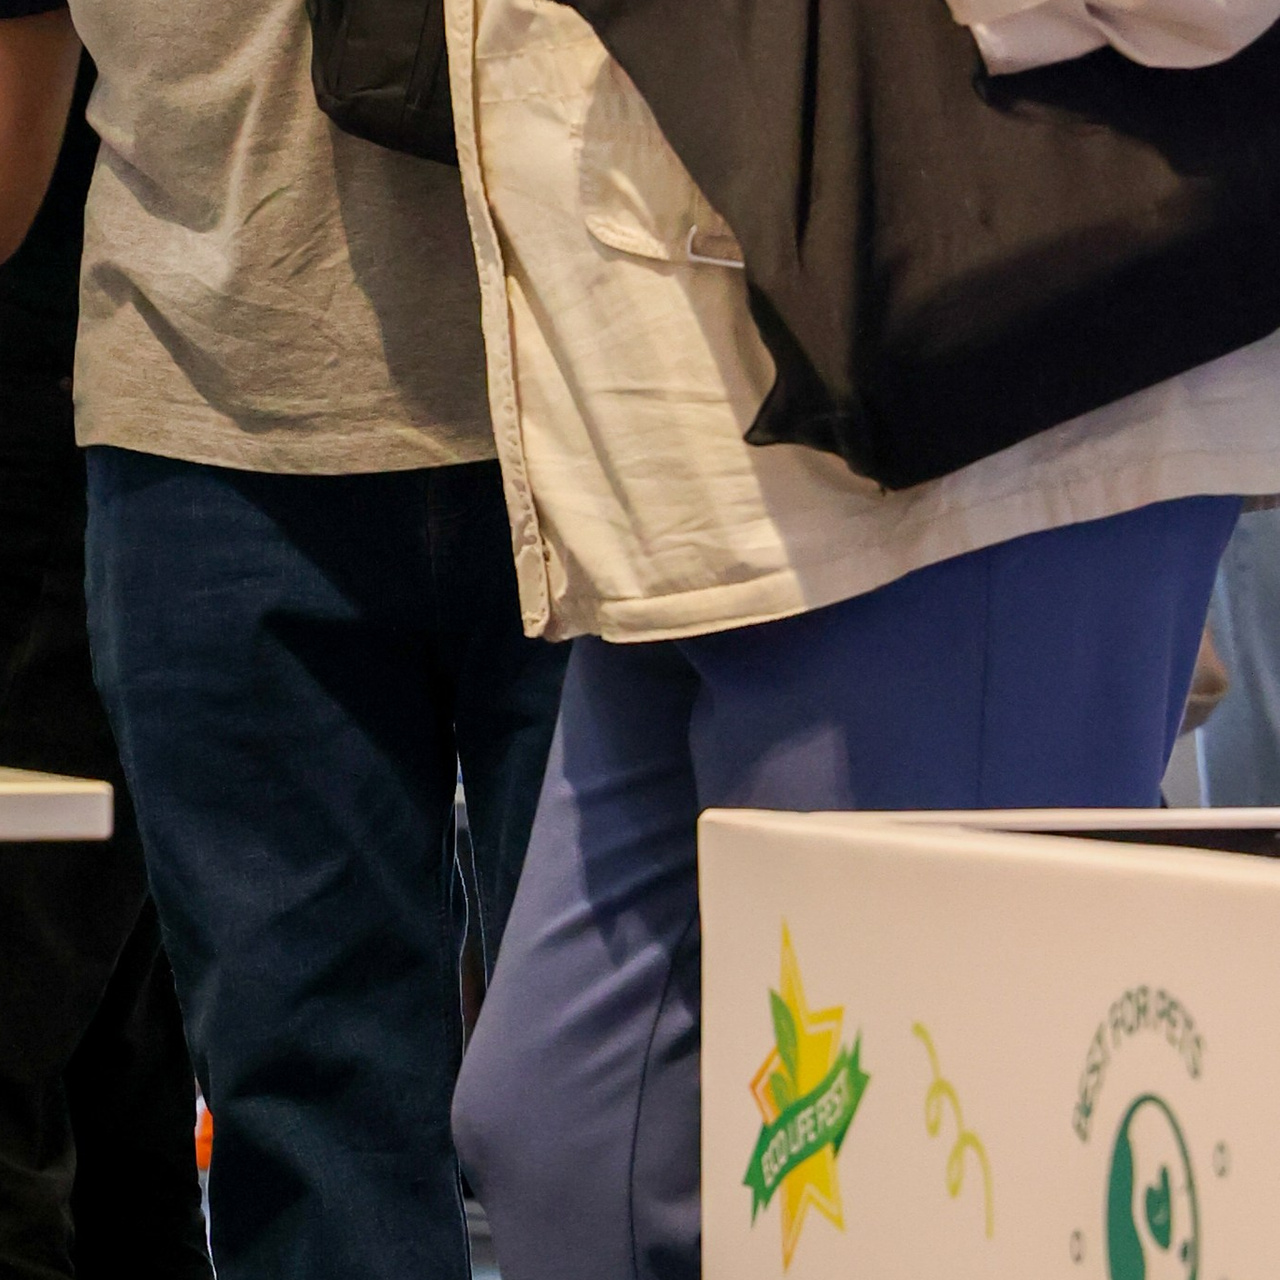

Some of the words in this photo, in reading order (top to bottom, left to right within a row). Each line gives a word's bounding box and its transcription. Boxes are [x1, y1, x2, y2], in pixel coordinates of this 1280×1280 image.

[761, 1128, 789, 1188] ECO
[787, 1104, 817, 1155] LIFE
[814, 1066, 848, 1134] FEST
[1072, 1022, 1110, 1142] BEST
[1109, 985, 1150, 1048] FOR
[1151, 990, 1204, 1079] PETS
